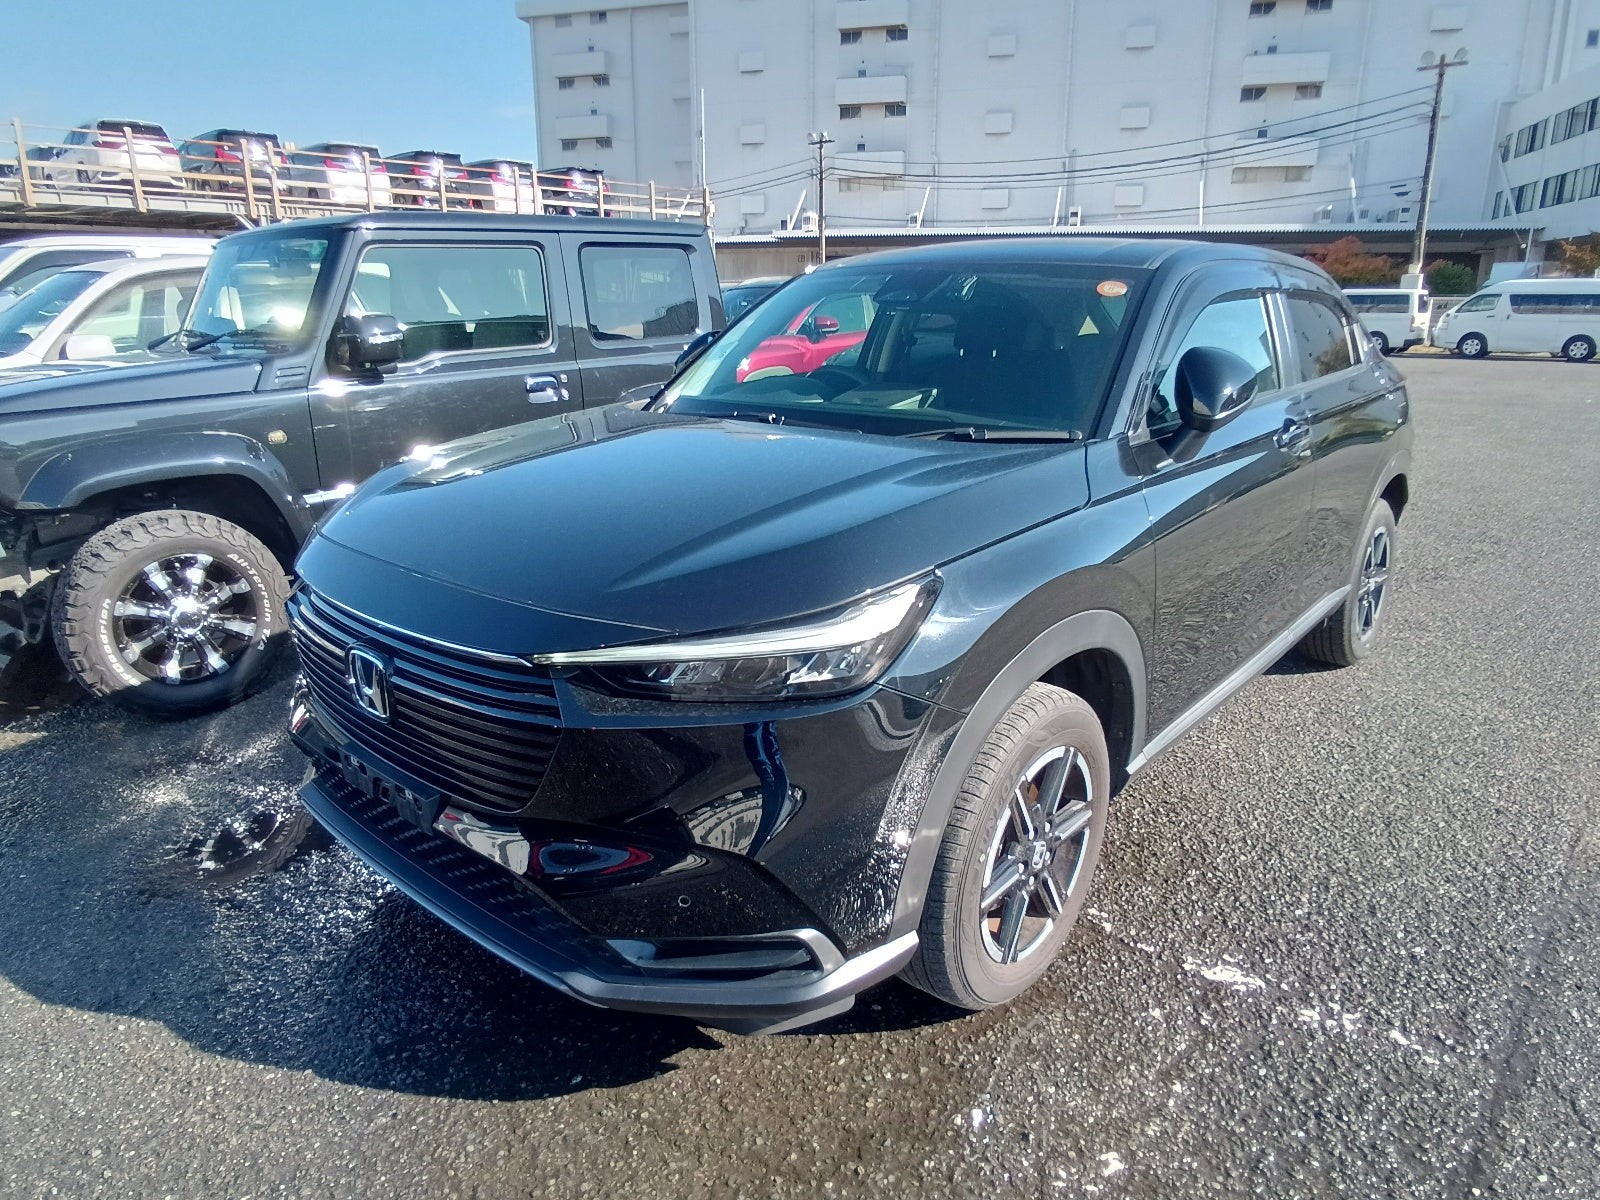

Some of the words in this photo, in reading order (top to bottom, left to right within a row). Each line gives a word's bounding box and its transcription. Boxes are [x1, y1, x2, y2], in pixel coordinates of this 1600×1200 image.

[99, 598, 142, 687] BFGoodrich
[227, 553, 272, 622] All-Terrain
[257, 628, 271, 651] T/A
